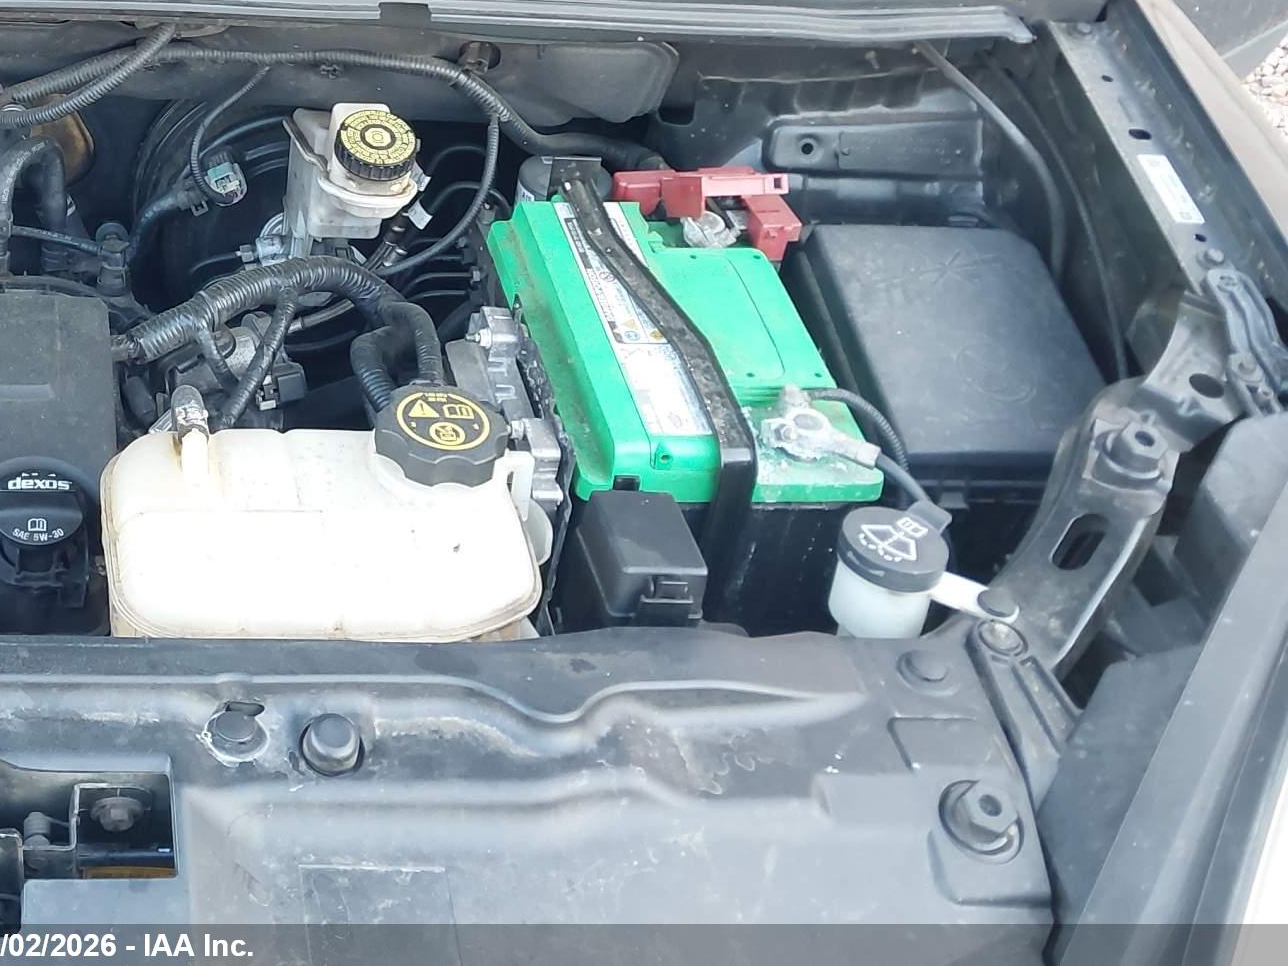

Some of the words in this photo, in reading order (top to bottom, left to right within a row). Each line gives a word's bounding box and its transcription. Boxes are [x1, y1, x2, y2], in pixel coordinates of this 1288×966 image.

[7, 477, 72, 490] dexos
[12, 528, 30, 541] SAE
[33, 528, 65, 542] 5W-30
